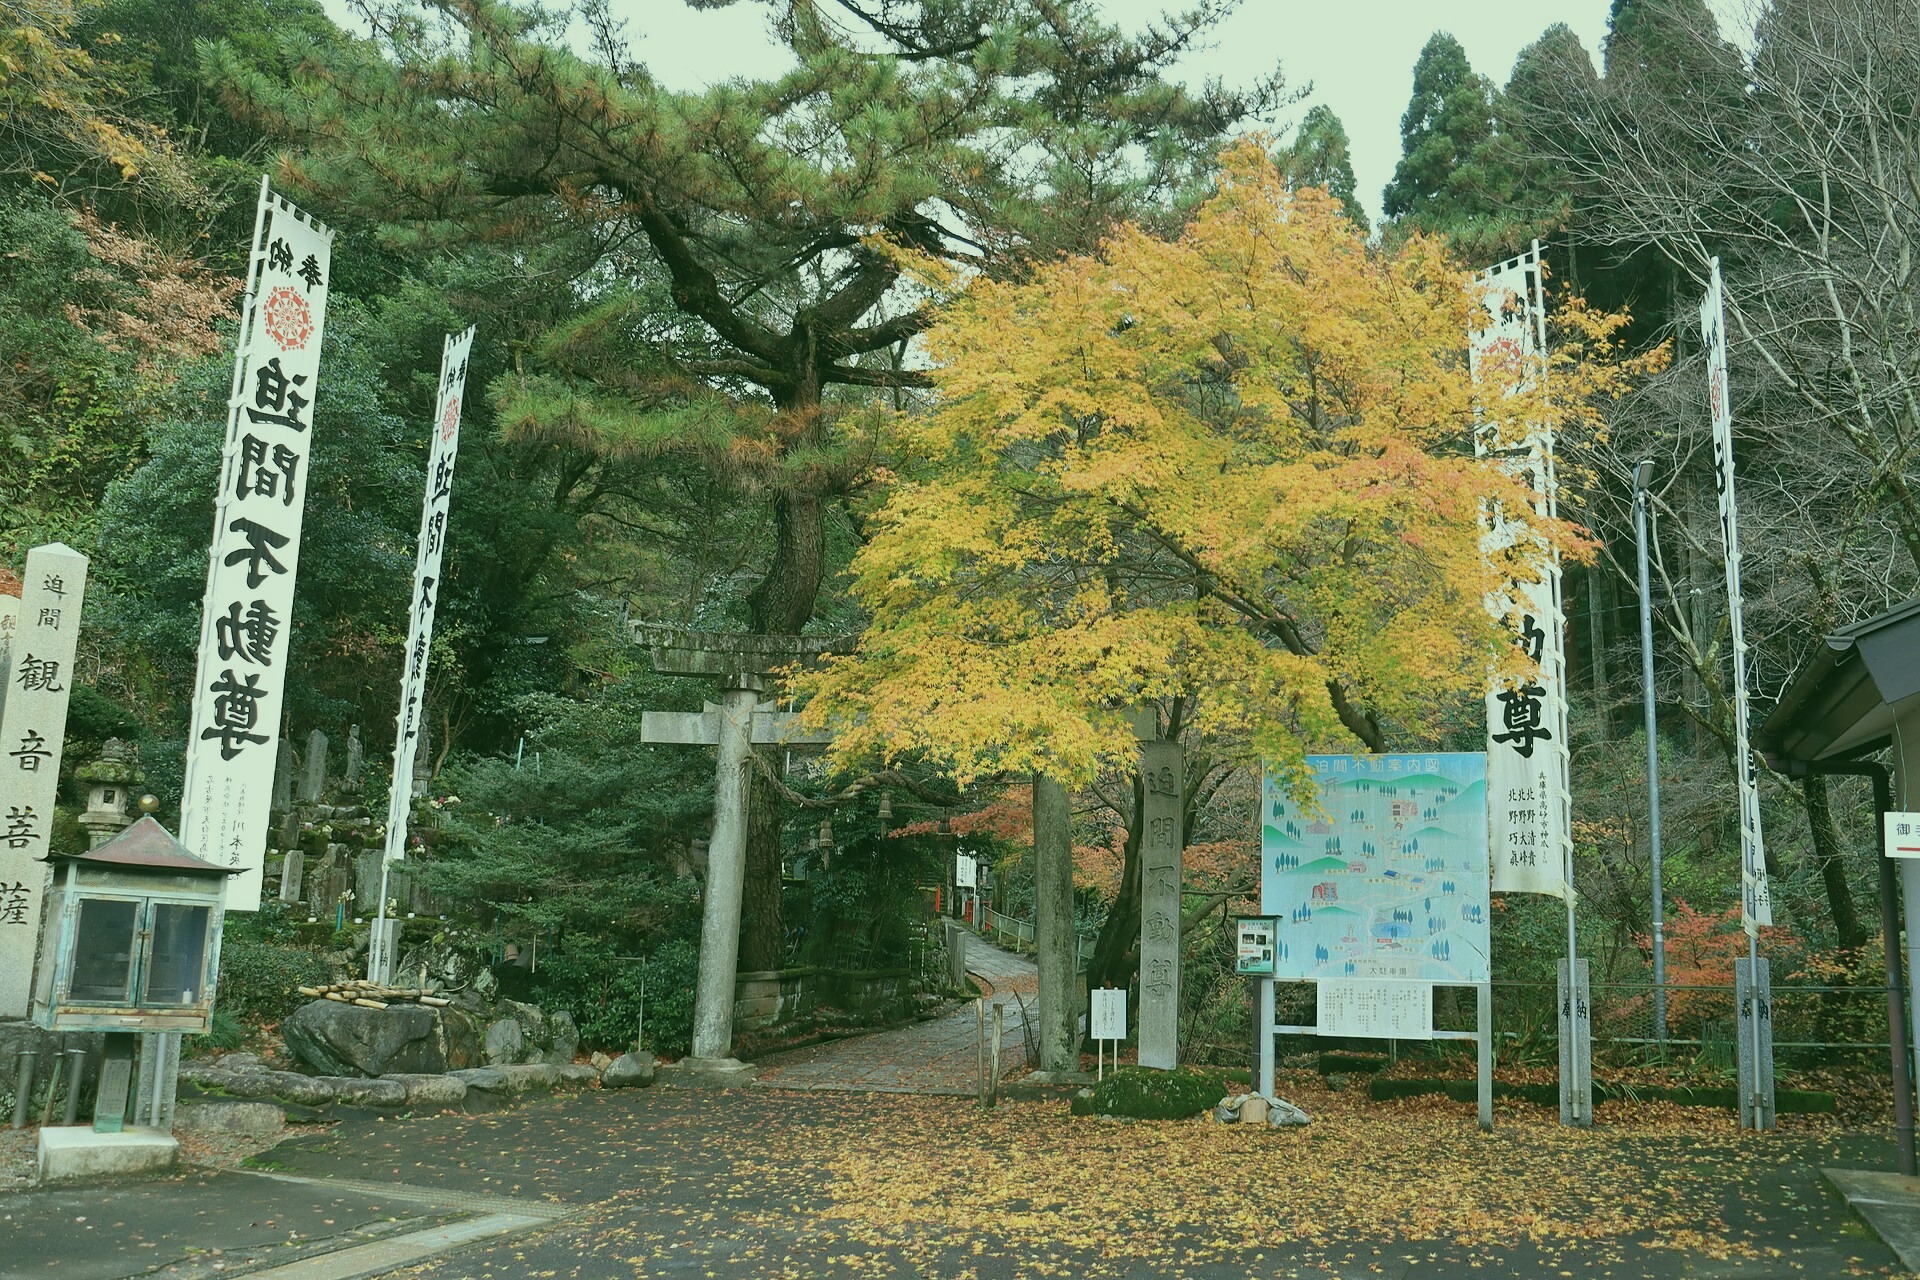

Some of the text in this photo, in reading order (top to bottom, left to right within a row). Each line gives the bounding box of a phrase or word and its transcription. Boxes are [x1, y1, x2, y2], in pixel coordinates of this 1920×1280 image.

[1316, 758, 1440, 773] 迫間不動案内図
[1144, 766, 1179, 999] 迫間不動尊
